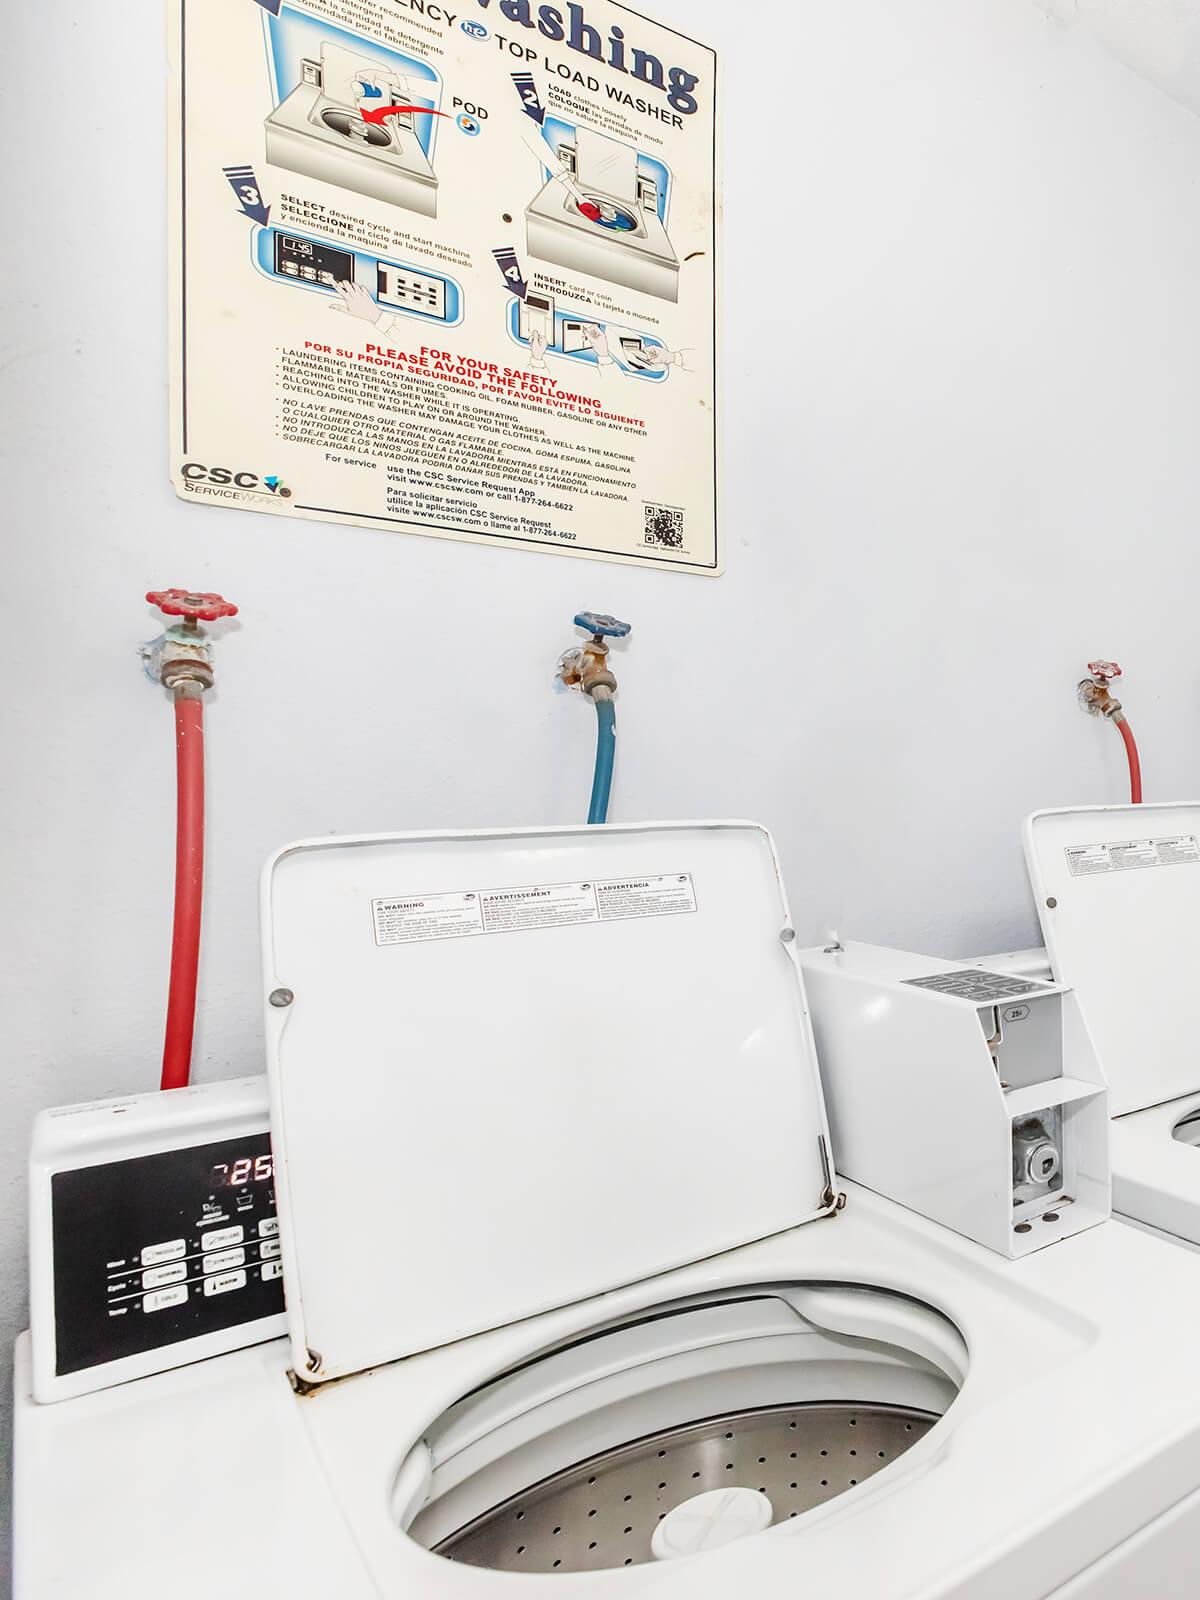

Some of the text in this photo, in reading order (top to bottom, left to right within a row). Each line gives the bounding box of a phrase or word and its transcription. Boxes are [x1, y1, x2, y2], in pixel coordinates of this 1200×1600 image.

[341, 7, 444, 56] cantidad de detergente
[379, 6, 443, 38] recommended
[476, 0, 697, 115] ashing
[494, 33, 683, 130] TOP LOAD WASHER
[523, 88, 539, 109] 2
[548, 83, 628, 122] LOAD clothes loosely
[452, 97, 488, 120] POD
[548, 92, 663, 145] COLOQUE las prendas de modo
[239, 185, 260, 205] 3
[280, 194, 470, 259] SELECT desired cycle and start machine
[281, 204, 354, 231] SELECCIONE
[367, 229, 390, 243] ciclo
[392, 239, 403, 247] de
[405, 238, 435, 256] lavado
[436, 247, 472, 268] deseado
[504, 265, 521, 282] 4
[534, 273, 566, 287] INSERT
[569, 284, 586, 294] card
[596, 293, 612, 302] coin
[534, 281, 592, 303] INTRODUZCA
[594, 299, 601, 307] la
[602, 302, 625, 314] tarjeta
[632, 312, 659, 324] moneda
[281, 356, 447, 399] FLAMMABLE MATERIALS OR FUMES.
[304, 341, 645, 428] POR SU PROPIA SEGURIDAD, POR FAVOR EVITE LO SIGUIENTE
[365, 343, 601, 408] PLEASE AVOID THE FOLLOWING
[420, 346, 557, 388] FOR YOUR SAFETY
[282, 365, 334, 382] REACHING
[336, 377, 360, 388] INTO
[362, 382, 380, 392] THE
[382, 387, 421, 401] WASHER
[423, 396, 450, 408] WHILE
[452, 402, 460, 410] IT
[472, 407, 520, 423] OPERATING.
[181, 463, 259, 488] CSC
[325, 453, 377, 469] For service
[387, 465, 536, 499] use the CSC Service Request App
[387, 474, 407, 483] visit
[409, 478, 484, 496] www.cscsw.com
[497, 490, 512, 501] call
[514, 495, 574, 511] 1-877-264-6622
